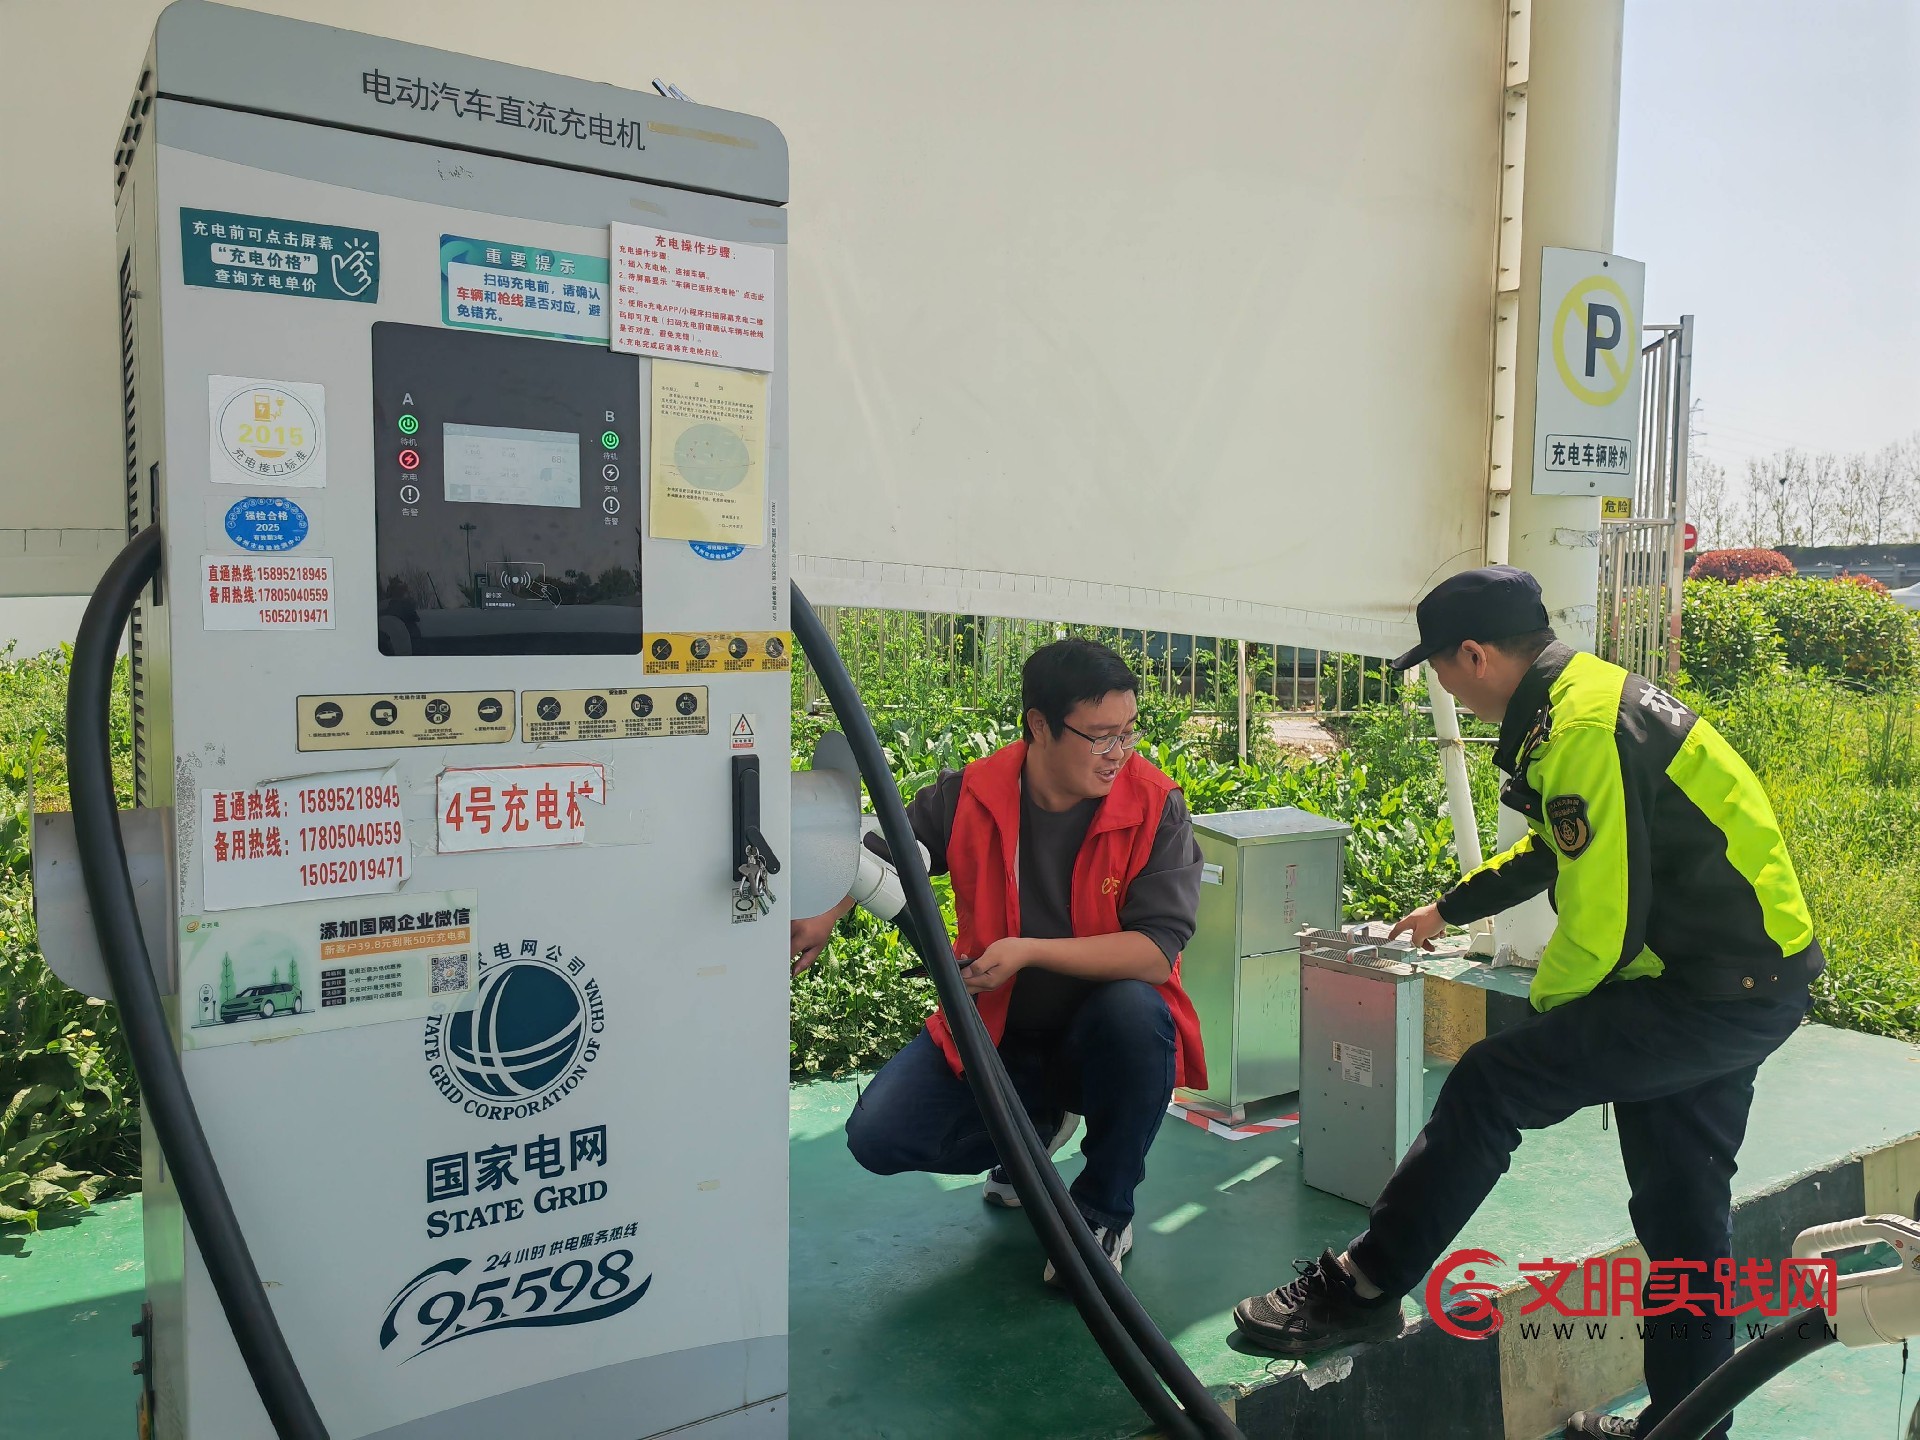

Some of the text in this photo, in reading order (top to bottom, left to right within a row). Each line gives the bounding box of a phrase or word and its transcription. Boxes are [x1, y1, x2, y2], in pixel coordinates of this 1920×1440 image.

[362, 68, 646, 150] 电动汽车直流充电机
[192, 220, 334, 250] 充电前可点击屏幕
[655, 235, 736, 260] 充电操作步骤：
[218, 246, 311, 271] “充电价格”
[485, 248, 575, 274] 重要提示
[215, 269, 317, 292] 查询充电单价
[484, 273, 600, 300] 扫码充电前，请确认
[457, 287, 600, 316] 车辆和枪线是否对应，避
[457, 304, 503, 322] 免错充。
[1585, 303, 1621, 377] P
[402, 393, 414, 406] A
[605, 410, 615, 422] B
[238, 424, 304, 447] 2015
[400, 438, 418, 447] 待机
[232, 448, 307, 473] 充电接口标准
[603, 452, 618, 461] 待机
[1552, 442, 1628, 469] 充电车辆除外
[401, 473, 418, 482] 充电
[604, 485, 618, 493] 充电
[245, 511, 288, 521] 强检合格
[401, 507, 419, 517] 告警
[1605, 498, 1628, 514] 危险
[256, 523, 280, 532] 2025
[259, 609, 328, 623] 15052019471
[213, 785, 400, 823] 直通热线： 15895218945
[214, 821, 401, 863] 备用热线： 17805040559
[300, 856, 403, 887] 15052019471
[320, 908, 470, 940] 添加国网企业微信
[325, 931, 467, 956] 新客户39.8元到账50元充电费
[584, 977, 604, 1034] CHINA
[584, 1037, 601, 1063] OF
[429, 1064, 464, 1104] GRID
[464, 1064, 588, 1120] CORPORATION
[426, 1124, 607, 1203] 国家电网
[426, 1180, 608, 1239] STATE GRID
[417, 1250, 634, 1346] 95598
